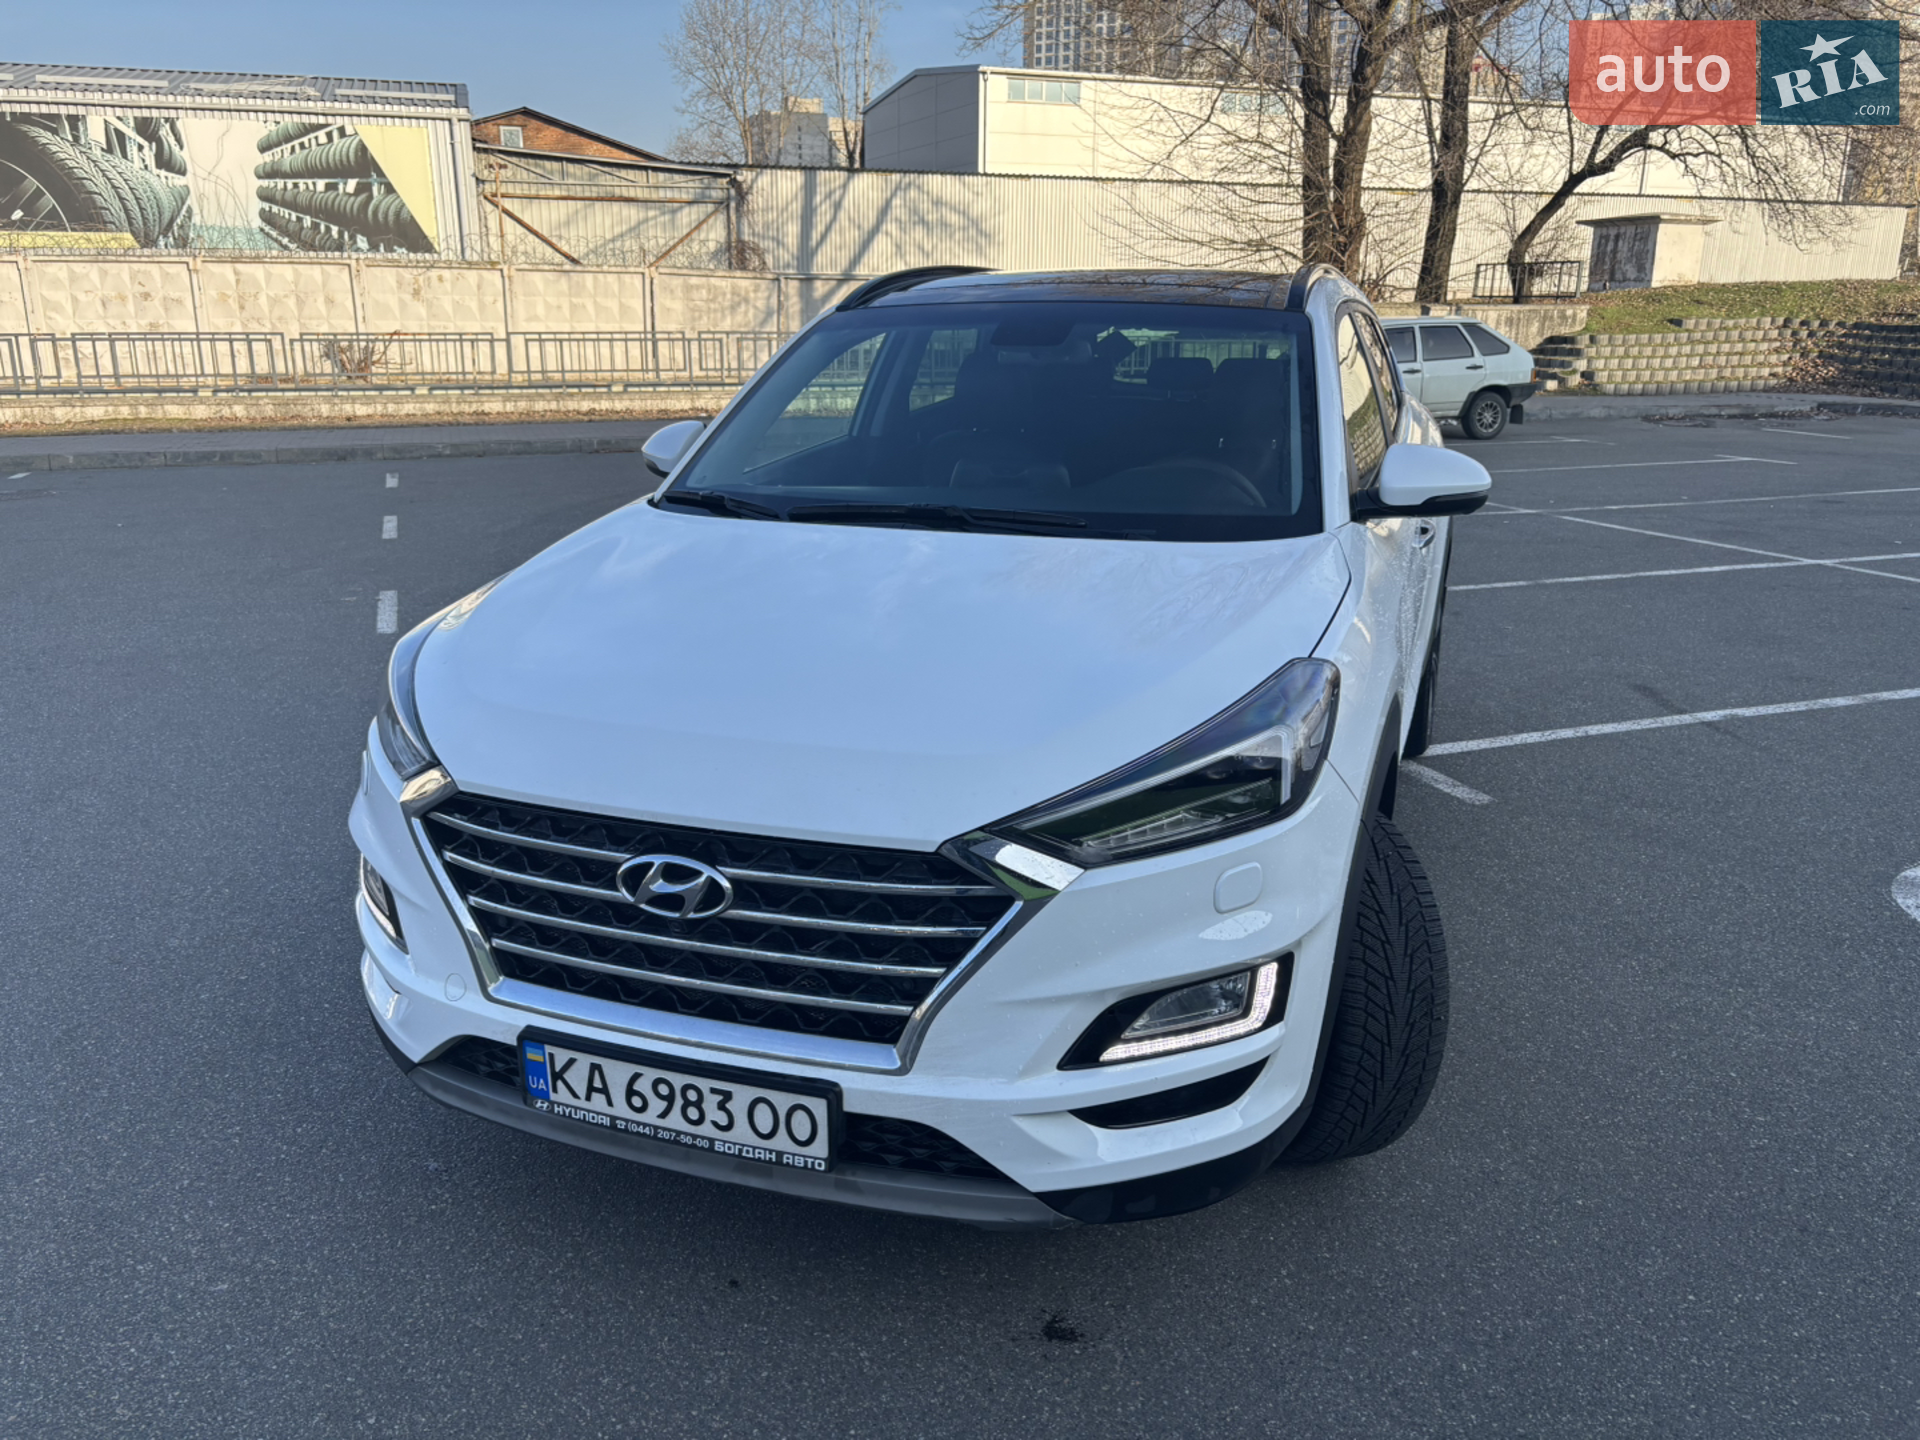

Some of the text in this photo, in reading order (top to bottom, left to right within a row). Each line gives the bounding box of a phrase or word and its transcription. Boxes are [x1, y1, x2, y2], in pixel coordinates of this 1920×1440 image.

[528, 1074, 548, 1092] UA
[547, 1051, 614, 1108] KA
[624, 1071, 736, 1133] 6983
[553, 1103, 710, 1149] HYUNDAI (044) 207-50-00
[714, 1140, 826, 1171] БОГДАН АВТО
